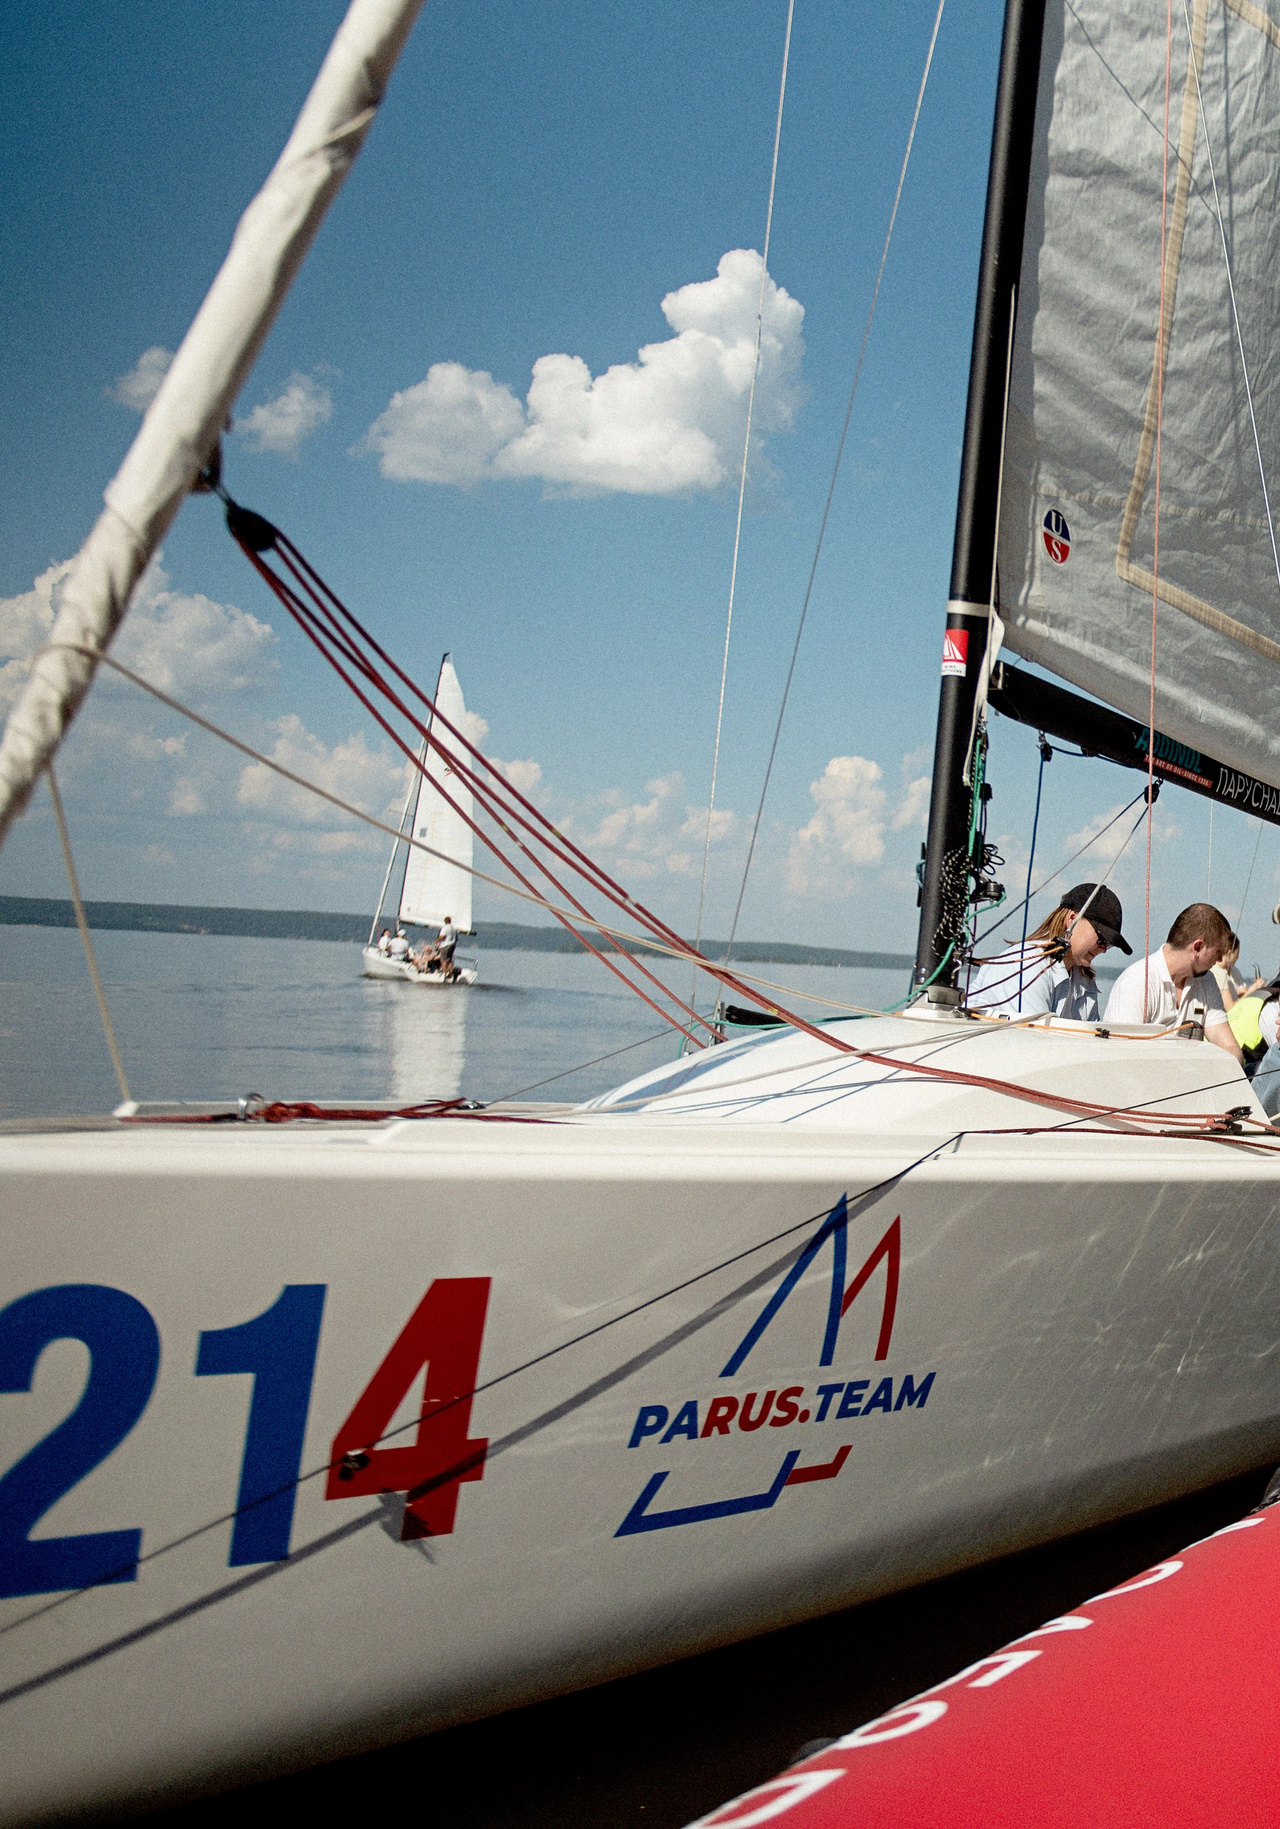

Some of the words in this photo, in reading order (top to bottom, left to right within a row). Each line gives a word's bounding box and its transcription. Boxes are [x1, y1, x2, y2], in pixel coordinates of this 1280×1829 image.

[1135, 727, 1202, 774] ADDINOL
[0, 1277, 492, 1599] 214
[627, 1372, 937, 1448] PARUS.TEAM
